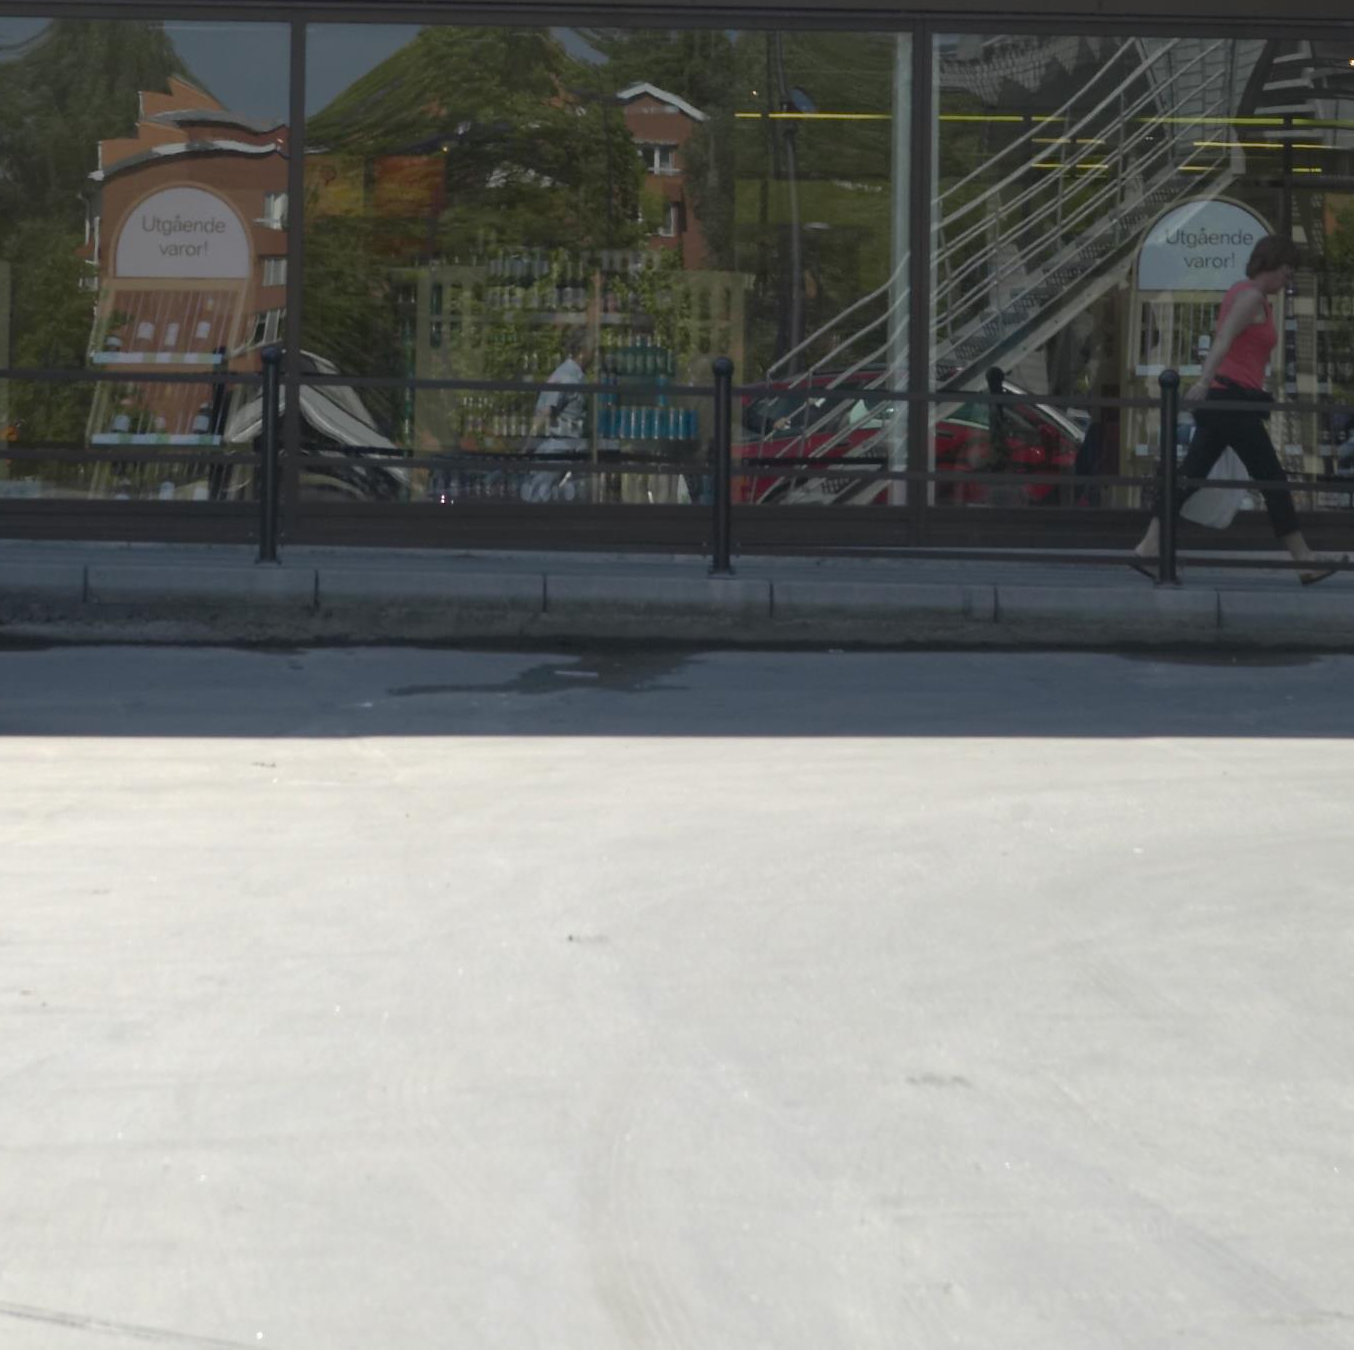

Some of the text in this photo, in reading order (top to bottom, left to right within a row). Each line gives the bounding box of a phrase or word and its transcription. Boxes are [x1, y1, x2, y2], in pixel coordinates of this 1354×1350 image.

[141, 214, 227, 236] Utgående
[1165, 227, 1254, 249] Utgående
[158, 240, 209, 257] varor!
[1183, 252, 1236, 269] varor!
